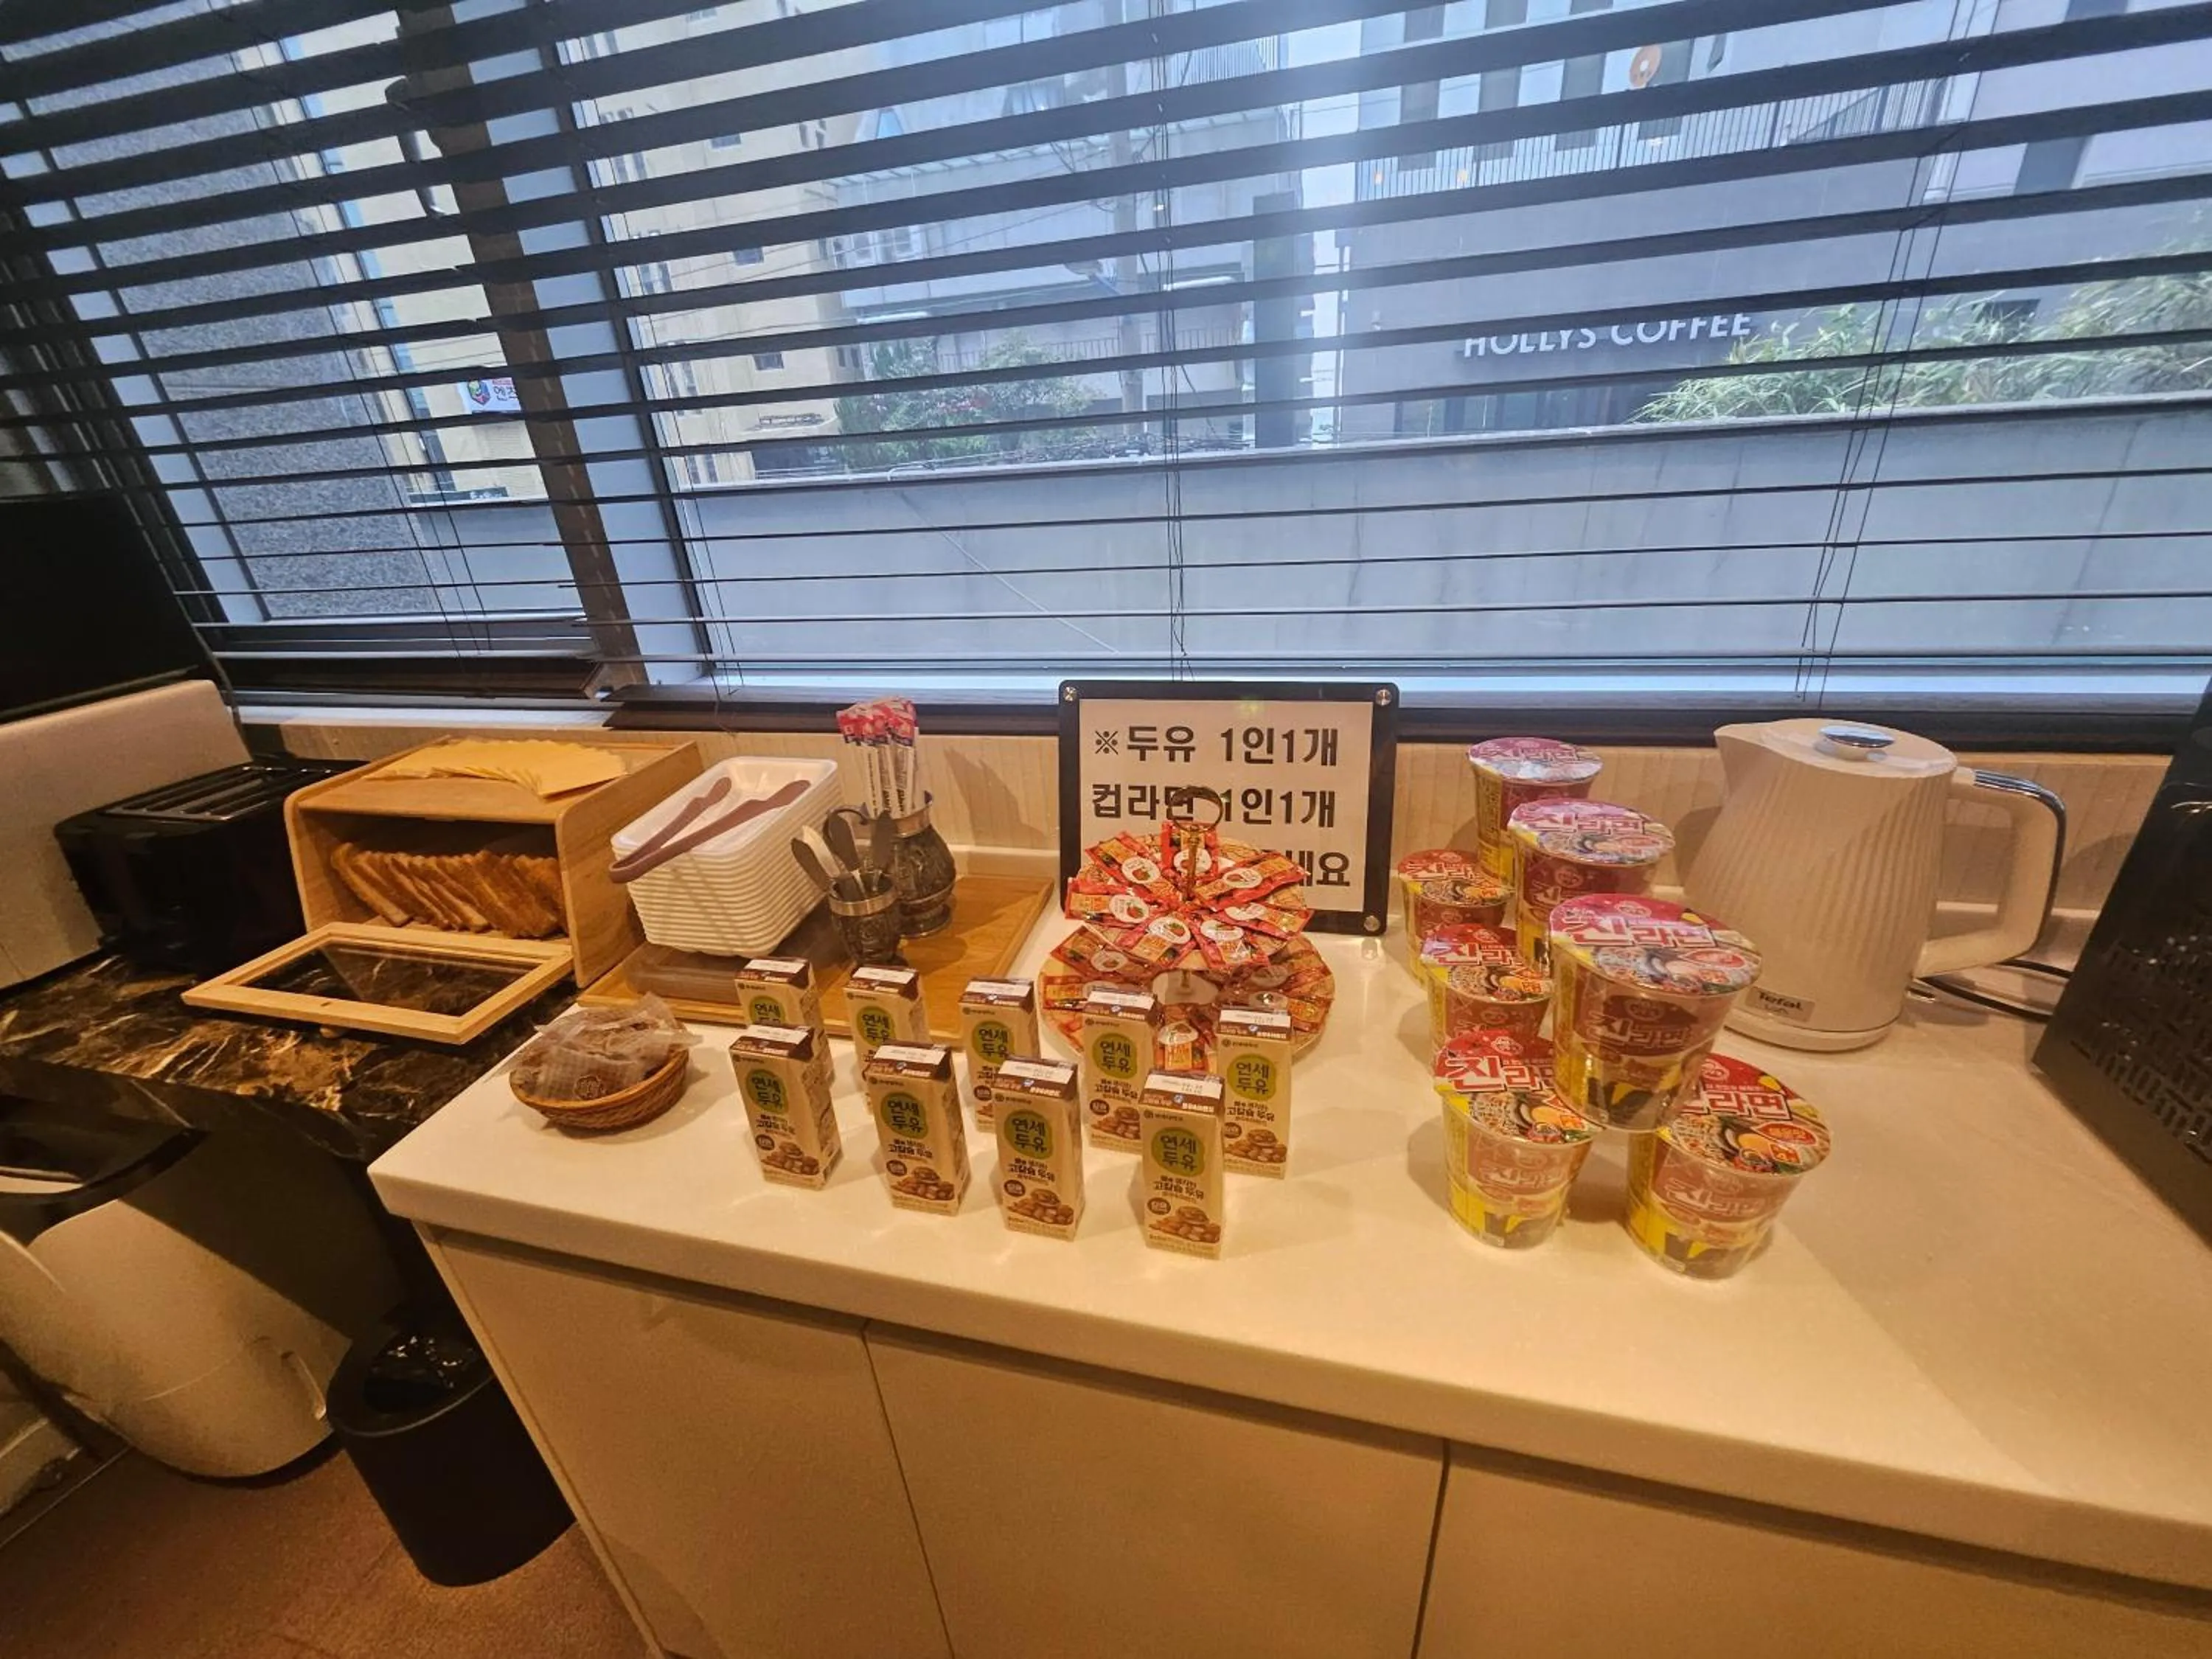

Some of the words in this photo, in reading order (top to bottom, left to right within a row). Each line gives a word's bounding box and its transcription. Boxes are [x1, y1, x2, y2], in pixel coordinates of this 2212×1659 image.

[1464, 328, 1597, 358] HOLLYS
[1611, 313, 1752, 346] COFFEE
[1220, 727, 1338, 766] 1인1개
[1092, 784, 1194, 822] 컵라면
[1220, 788, 1335, 828] 1인1개
[1562, 915, 1717, 948] 진라면
[1759, 991, 1804, 1011] Tefal
[862, 1014, 890, 1029] 연세
[978, 1029, 1009, 1045] 연세
[1099, 1040, 1131, 1057] 연세
[1236, 1062, 1270, 1079] 연세
[751, 1075, 782, 1096] 연세
[888, 1099, 919, 1118] 연세
[1012, 1117, 1046, 1137] 연세
[1160, 1134, 1197, 1155] 연세
